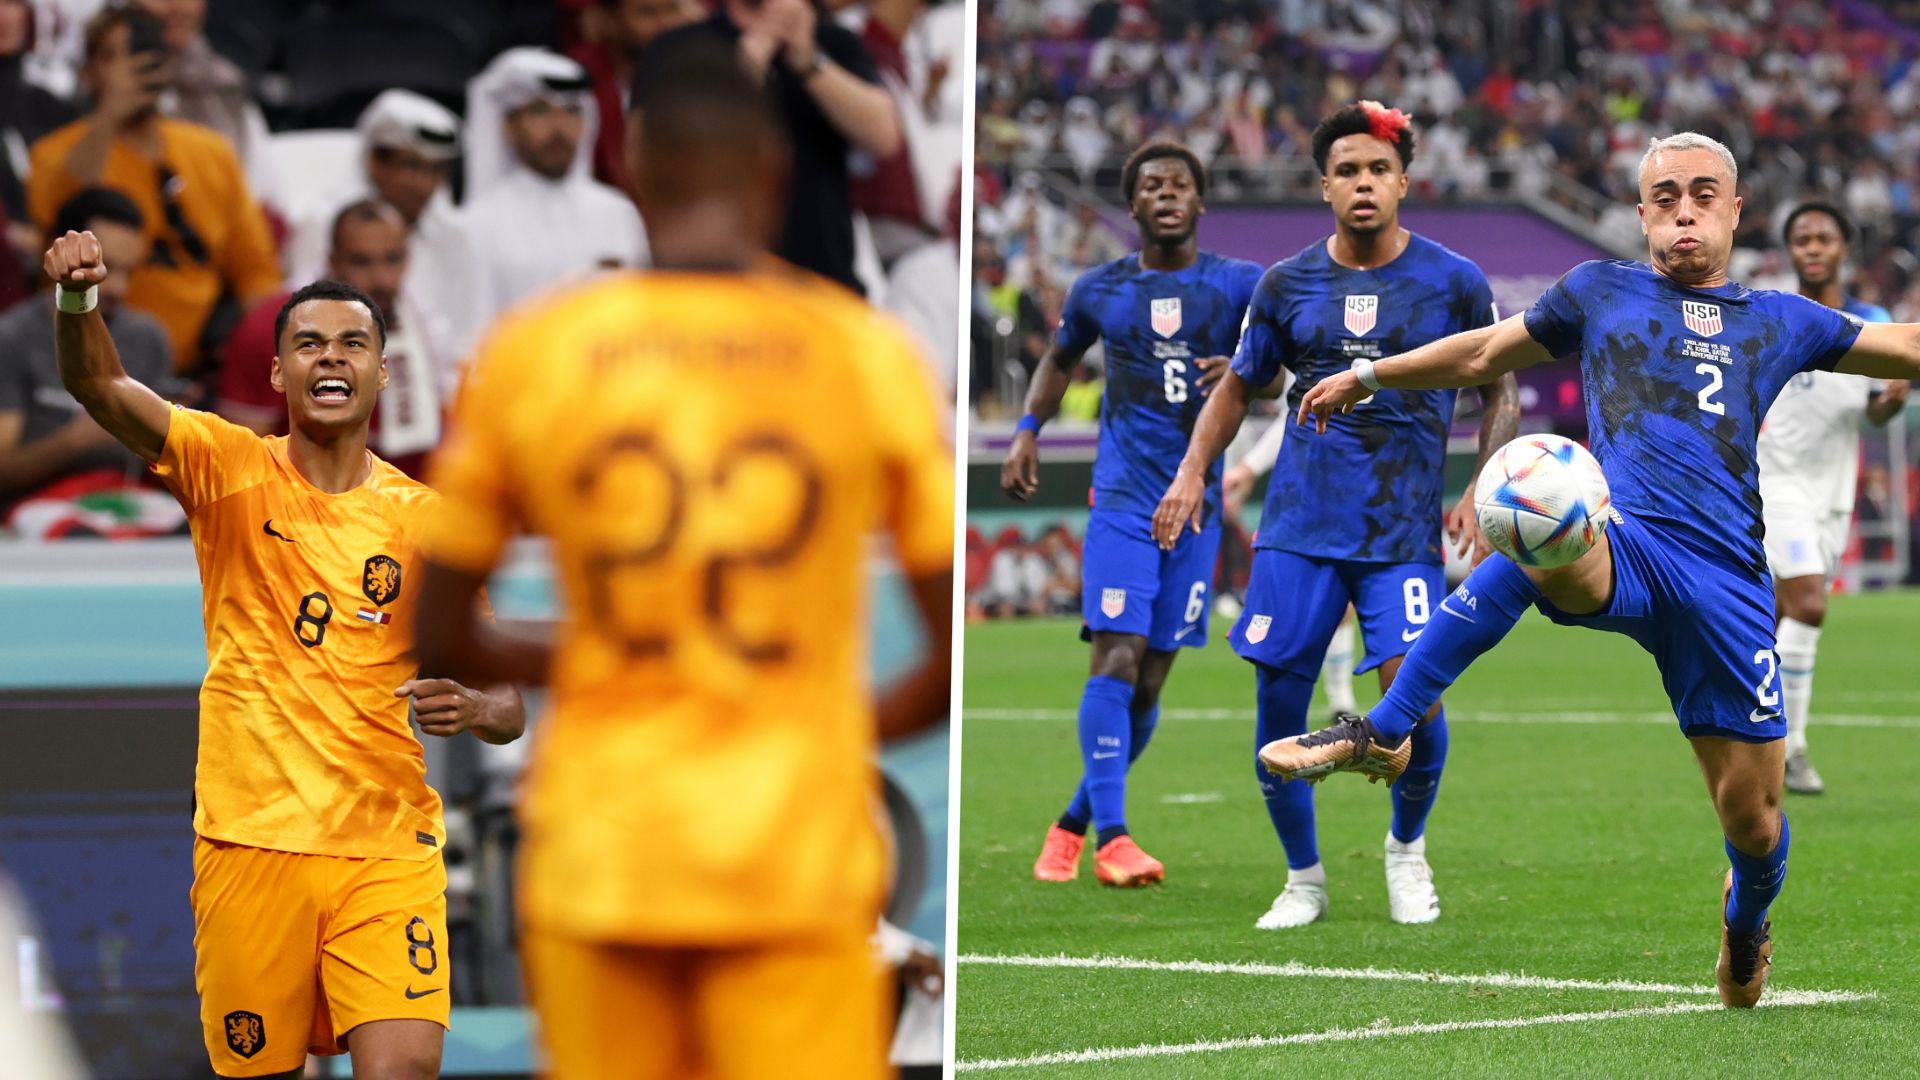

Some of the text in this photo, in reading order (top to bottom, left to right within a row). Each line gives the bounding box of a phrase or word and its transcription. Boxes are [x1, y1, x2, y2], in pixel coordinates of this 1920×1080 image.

[1348, 298, 1375, 313] USA
[1685, 303, 1719, 319] USA
[1683, 339, 1710, 348] ENGLAND
[1720, 344, 1731, 352] USA
[1690, 350, 1719, 362] NOVEMBER
[1719, 356, 1734, 365] 2022
[1711, 349, 1729, 358] QATAR
[1163, 359, 1188, 403] 6
[1695, 362, 1725, 416] 2
[572, 428, 824, 664] 22
[293, 591, 334, 649] 8
[1184, 580, 1207, 624] 6
[1403, 577, 1430, 625] 8
[1456, 585, 1478, 611] USA
[1754, 649, 1779, 707] 2
[1096, 735, 1121, 747] USA
[405, 915, 438, 976] 8
